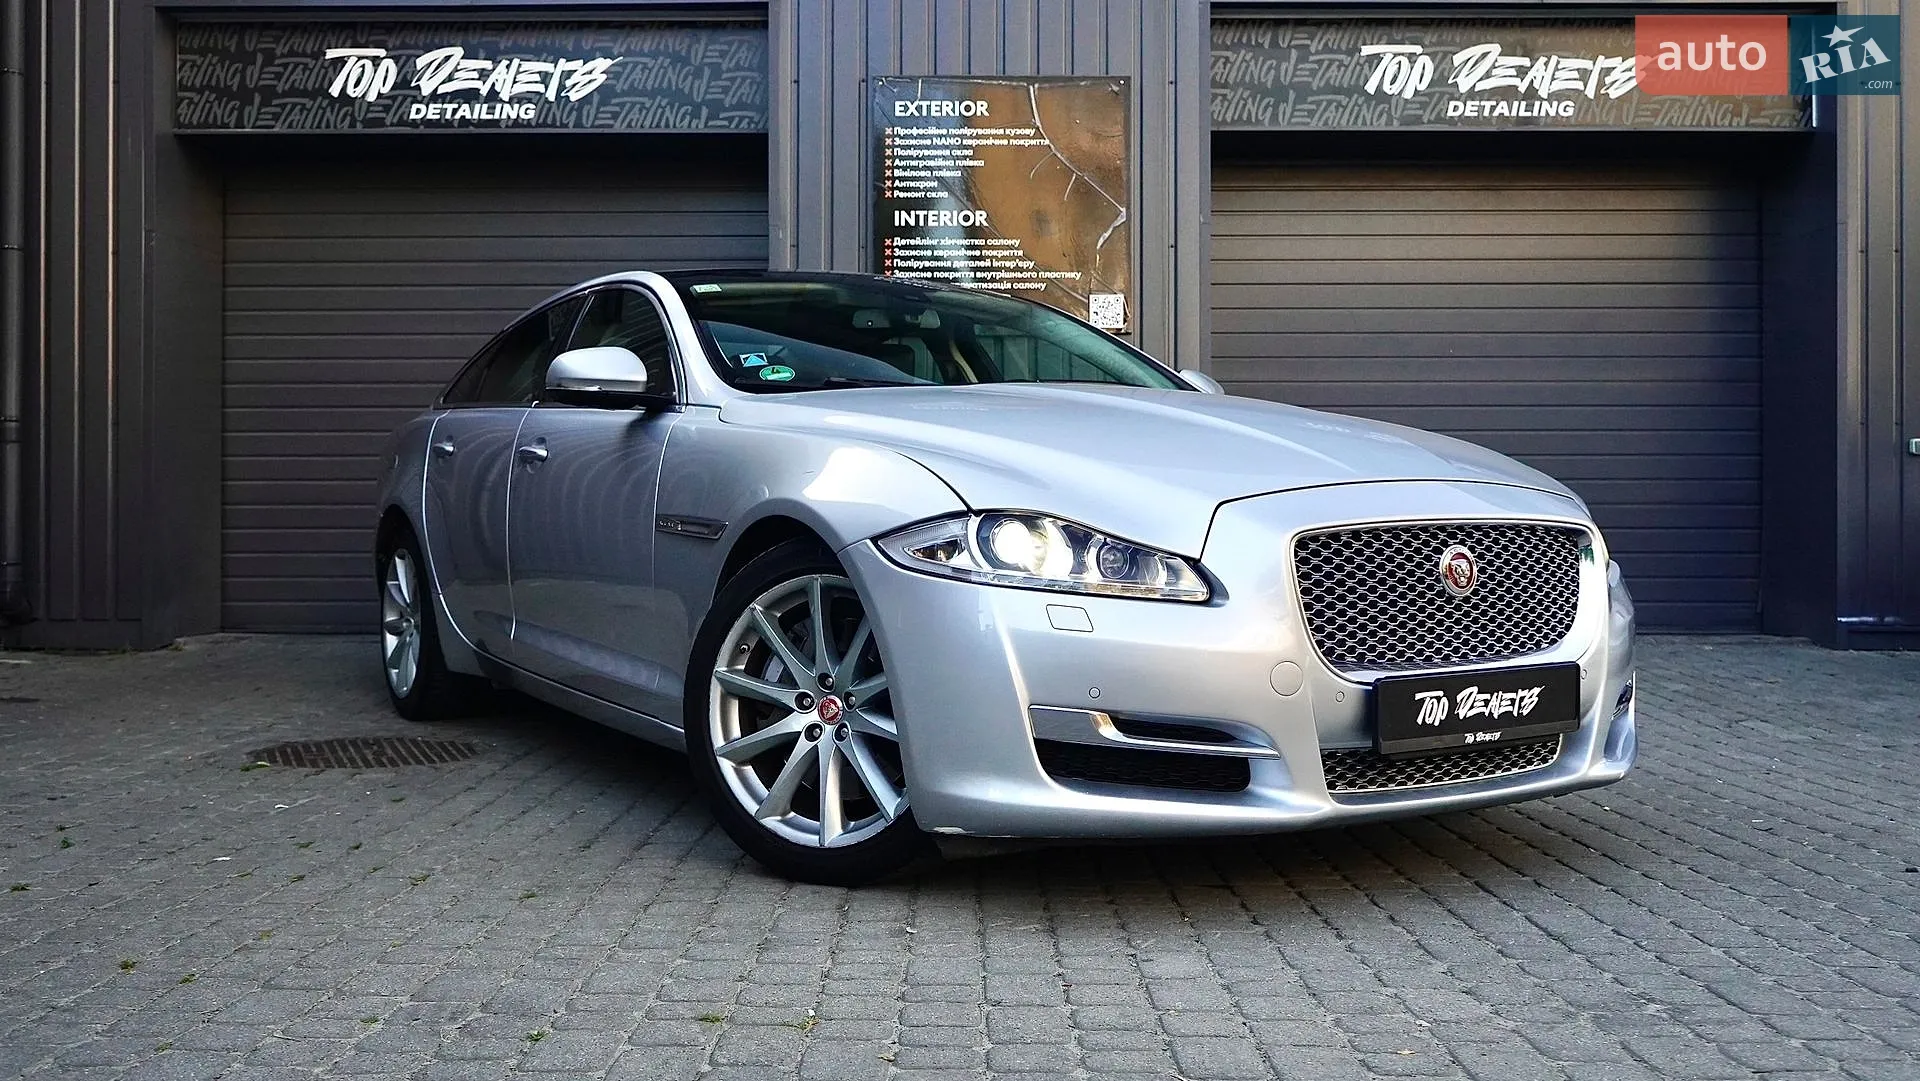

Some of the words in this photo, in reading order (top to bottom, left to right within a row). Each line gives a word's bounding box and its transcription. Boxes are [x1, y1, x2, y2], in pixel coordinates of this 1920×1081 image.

[409, 104, 537, 120] DETAILING
[894, 100, 989, 117] EXTERIOR
[1446, 101, 1576, 118] DETAILING
[894, 126, 948, 136] Професійне
[949, 127, 1004, 136] полірування
[933, 138, 961, 146] NANO
[894, 148, 951, 158] Полірування
[932, 169, 962, 178] плівка
[894, 190, 925, 199] Ремонт
[894, 210, 988, 227] INTERIOR
[893, 258, 952, 269] Полірування
